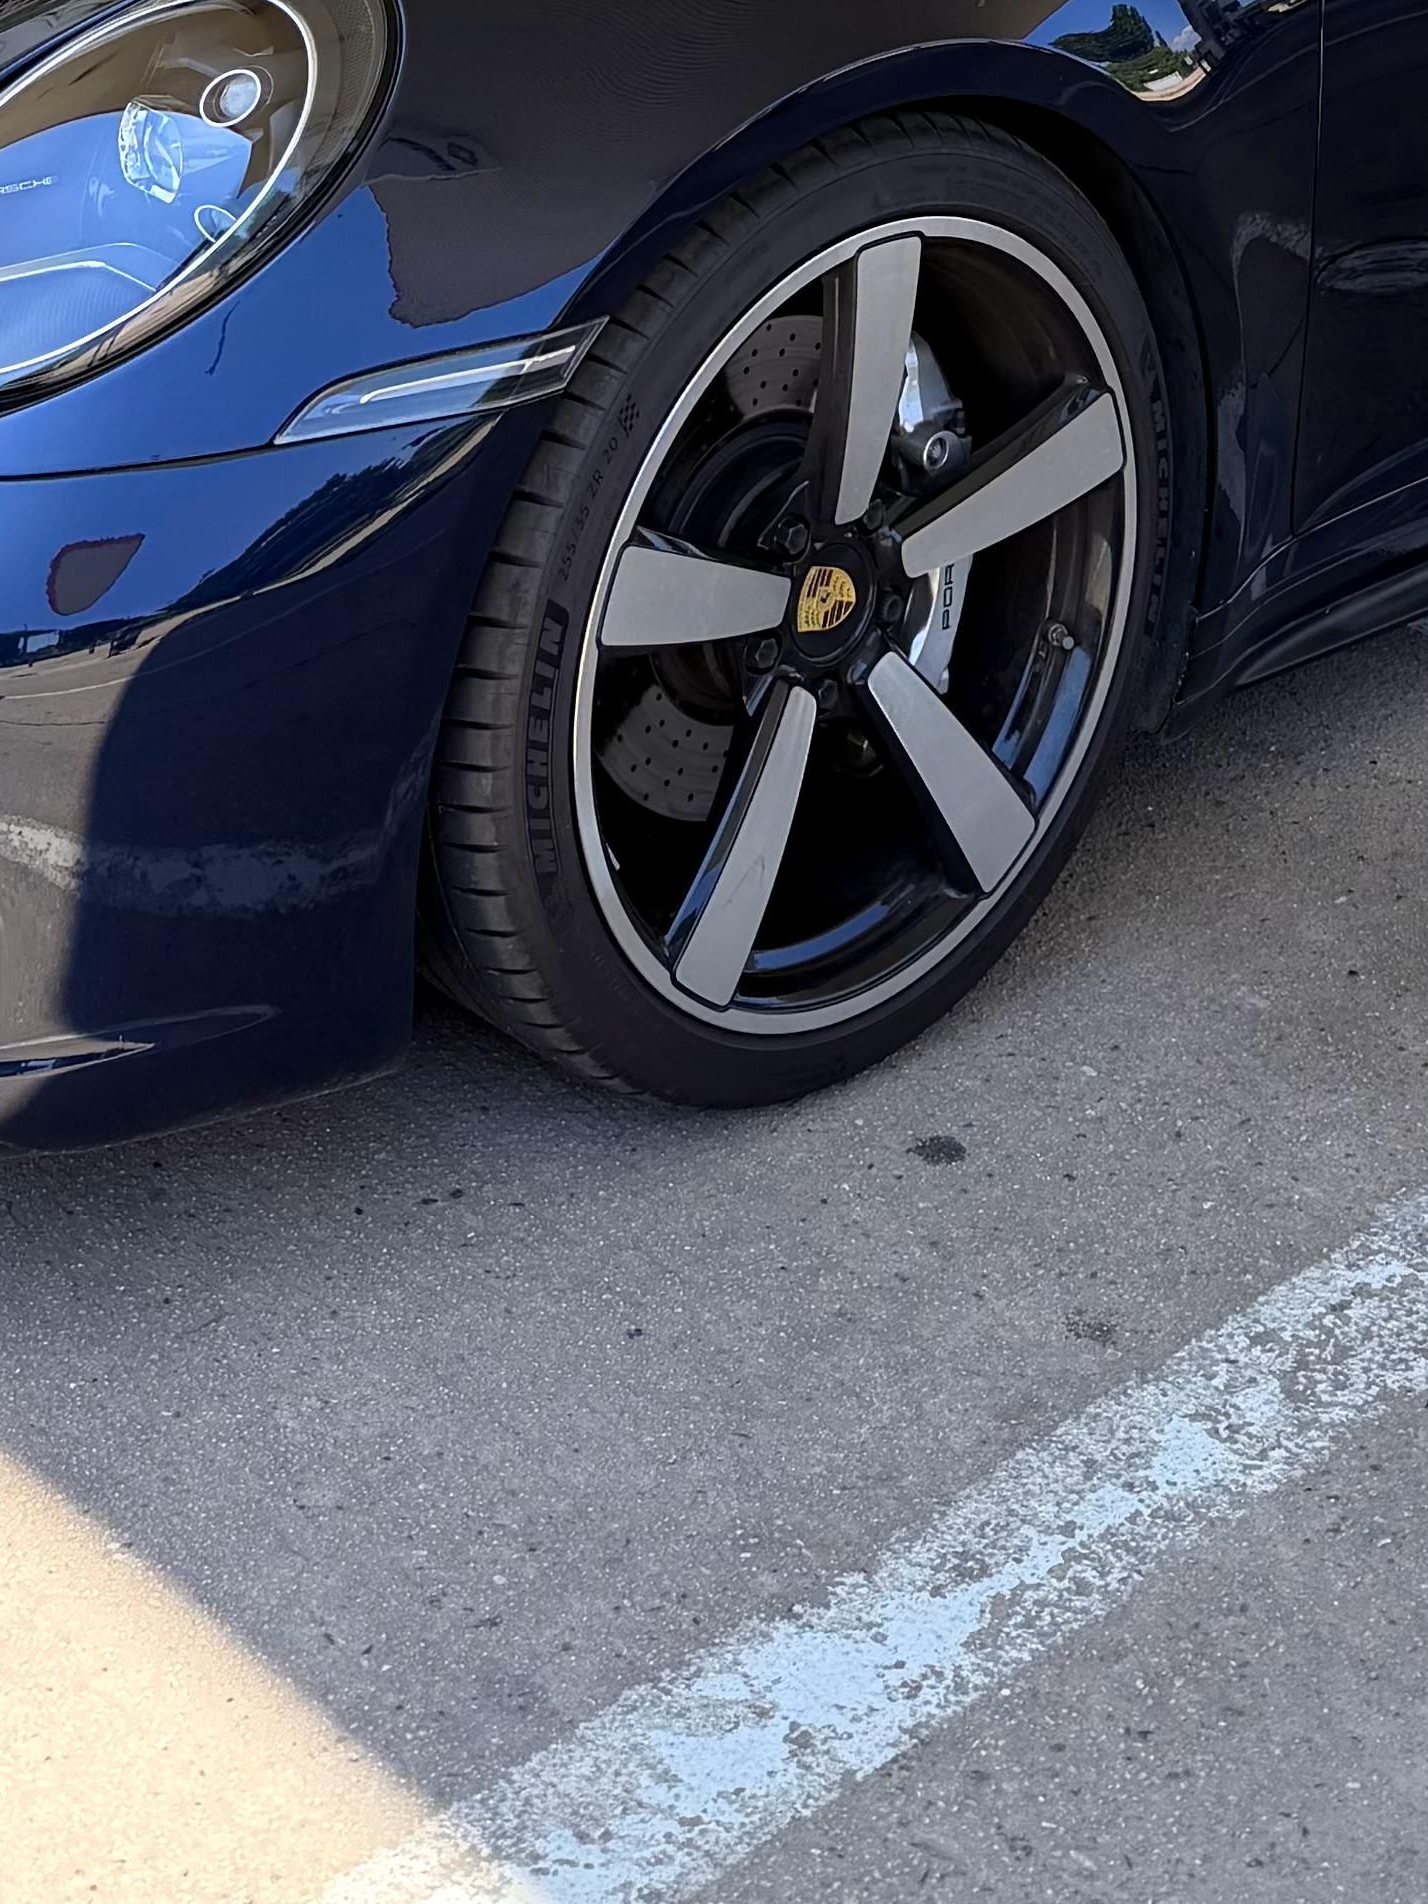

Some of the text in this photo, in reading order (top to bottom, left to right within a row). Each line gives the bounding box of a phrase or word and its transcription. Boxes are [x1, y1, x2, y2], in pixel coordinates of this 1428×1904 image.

[587, 468, 605, 502] ZR
[602, 436, 619, 466] 20
[1148, 399, 1169, 624] MICHELIN
[527, 614, 565, 876] MICHELIN
